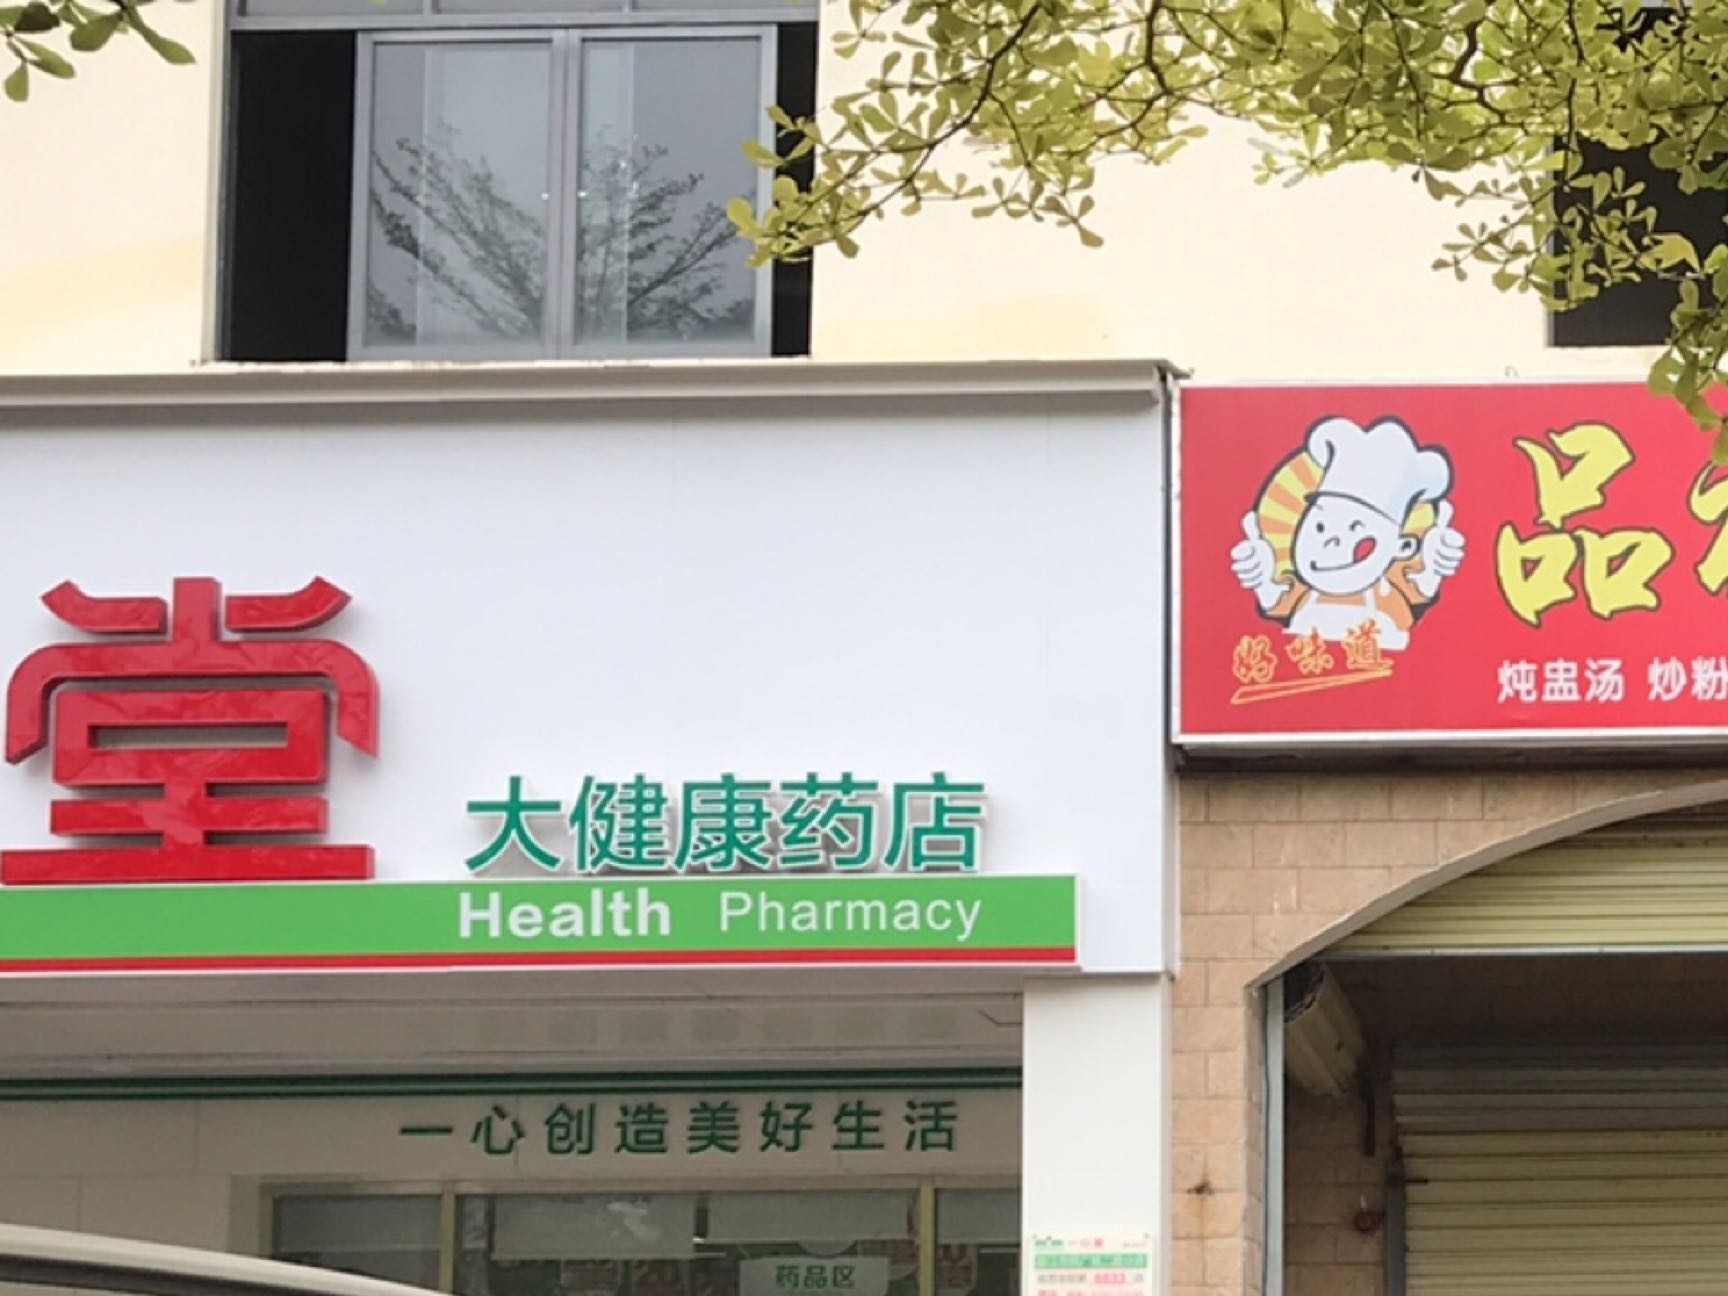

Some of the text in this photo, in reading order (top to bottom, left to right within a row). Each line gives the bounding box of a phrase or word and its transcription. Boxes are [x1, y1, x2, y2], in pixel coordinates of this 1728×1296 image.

[1498, 659, 1625, 704] 炖盅汤
[0, 575, 378, 884] 堂
[464, 772, 987, 874] 大健康药店
[458, 888, 982, 943] Health Pharmacy
[399, 1099, 961, 1157] 一心创造美好生活
[775, 1264, 857, 1291] 药品区
